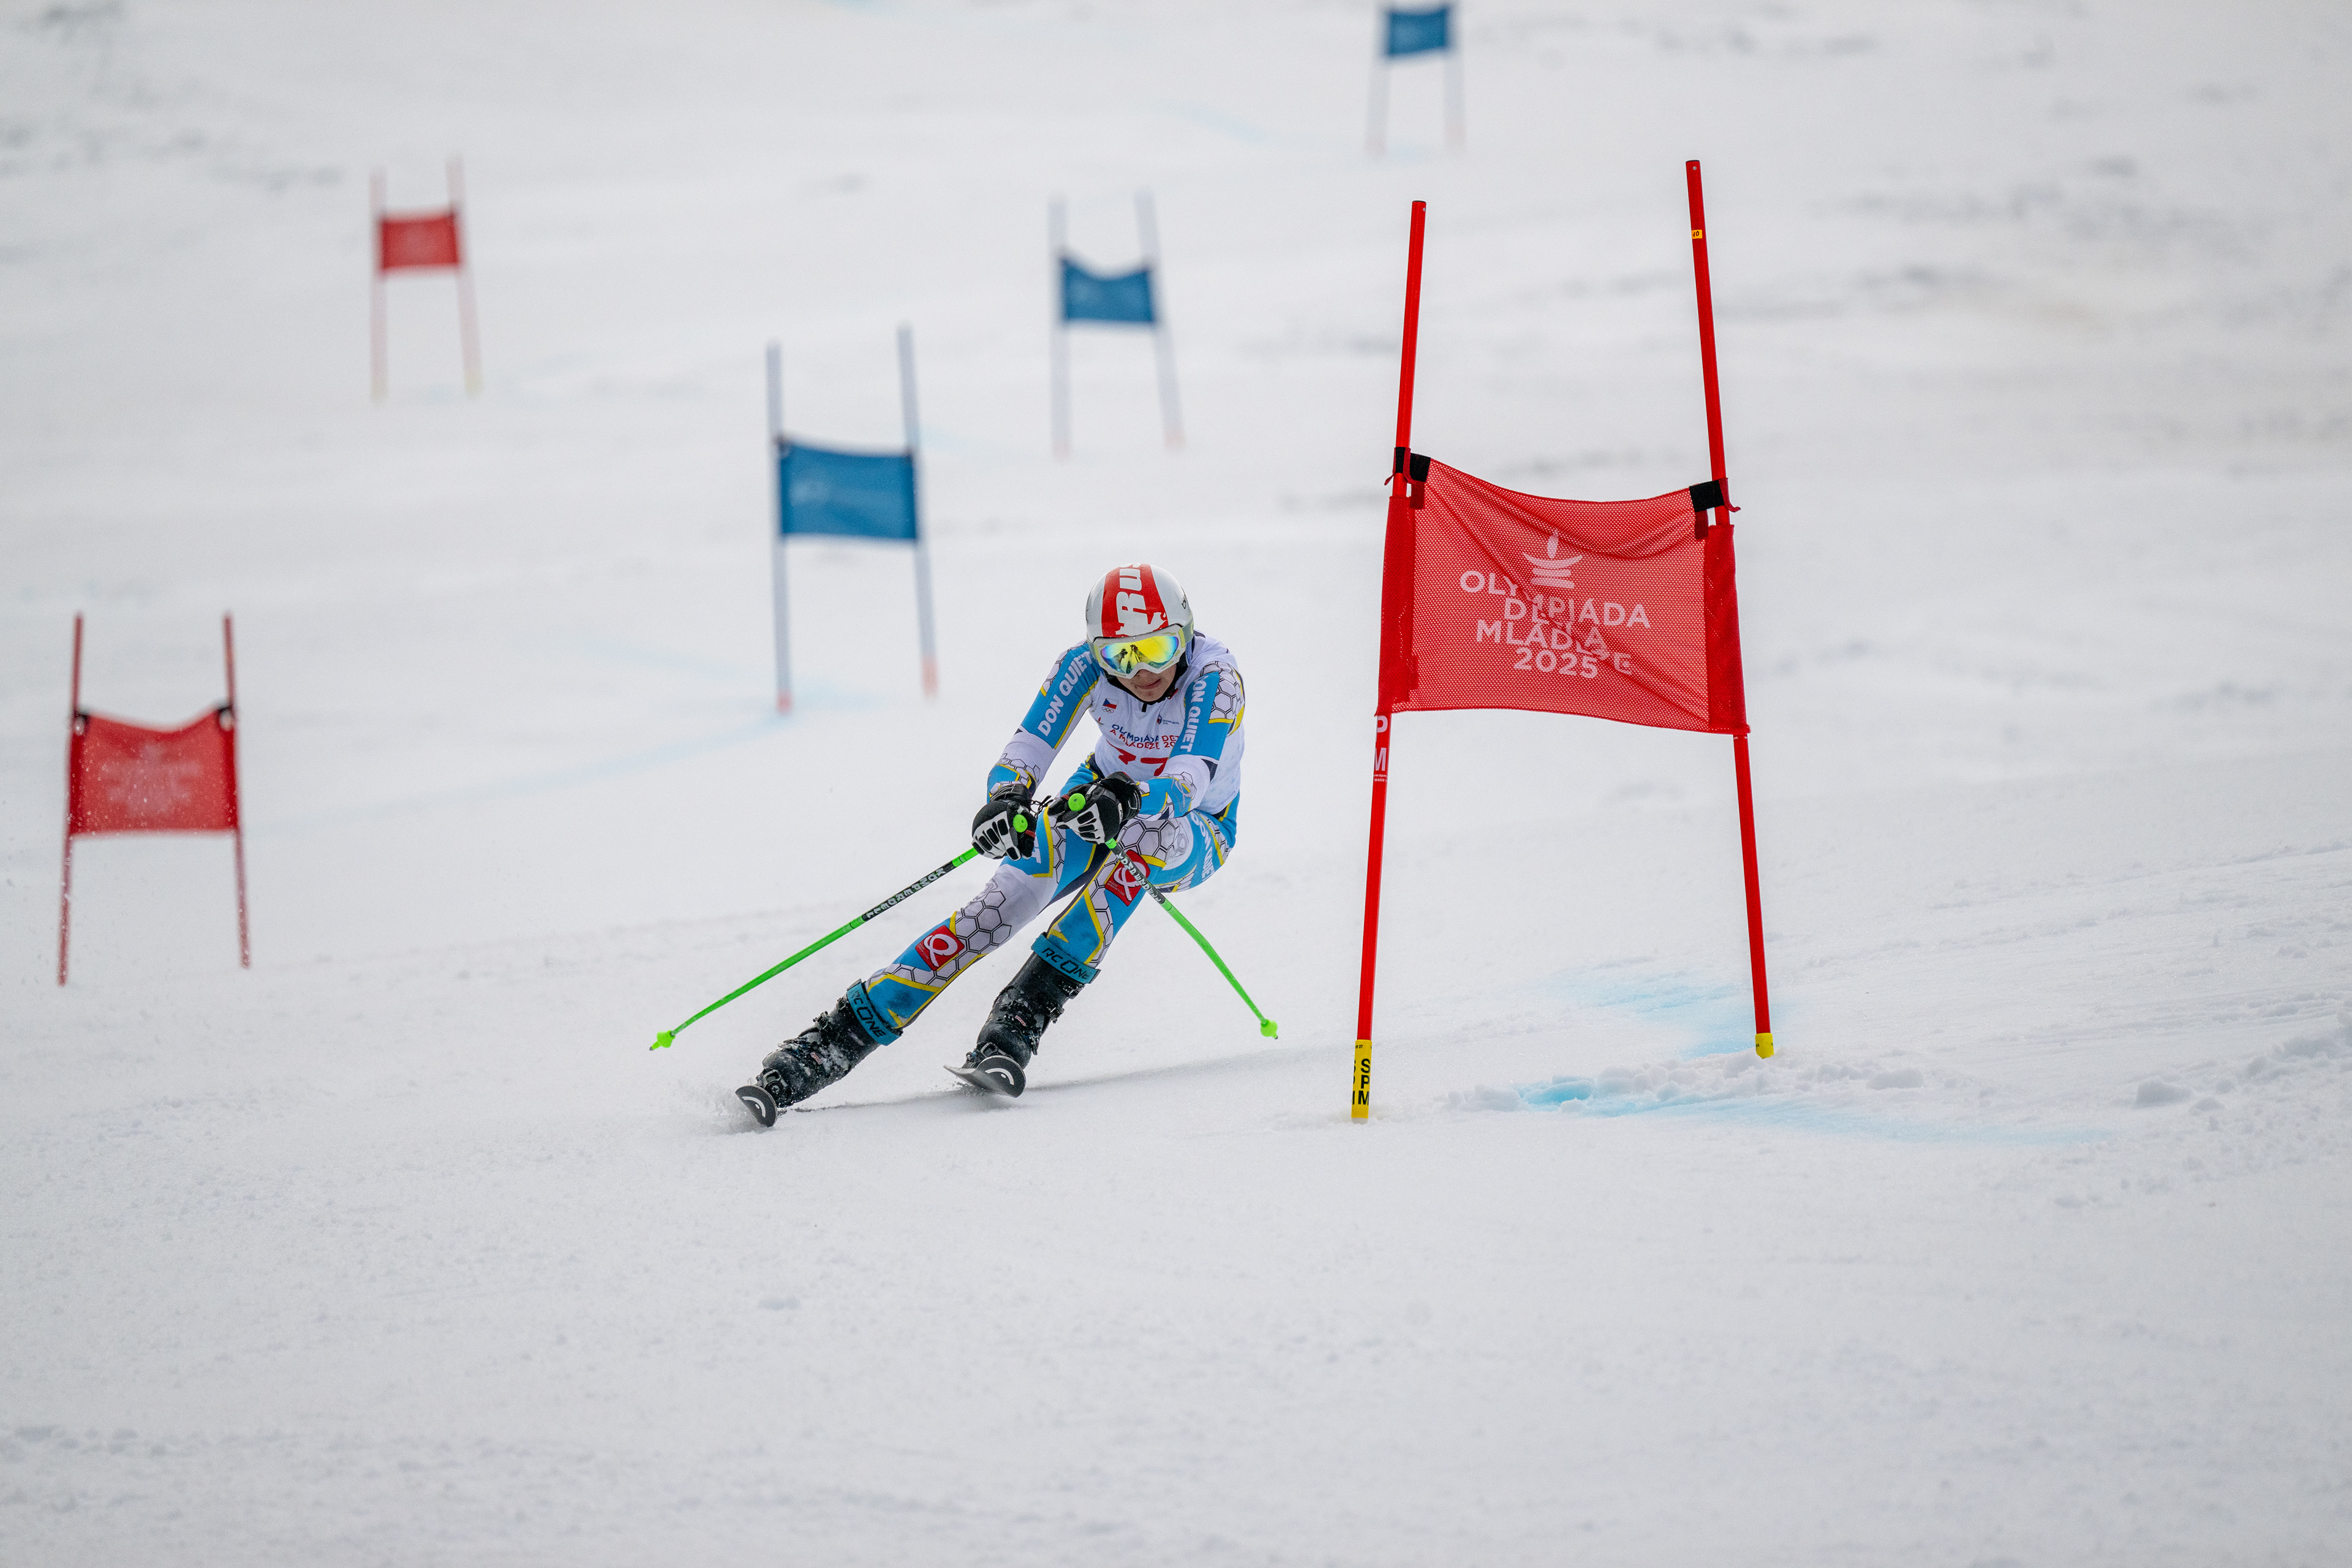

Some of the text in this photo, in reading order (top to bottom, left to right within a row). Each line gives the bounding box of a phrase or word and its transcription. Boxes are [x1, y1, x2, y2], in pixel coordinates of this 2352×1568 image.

[1513, 647, 1598, 679] 2025
[1037, 650, 1093, 737] DON QUIET
[1180, 676, 1208, 753] ON QUIET
[1202, 846, 1215, 882] QUIE
[865, 867, 947, 919] KOMPERDELL
[1060, 959, 1090, 980] ONE
[856, 1006, 887, 1038] ONE
